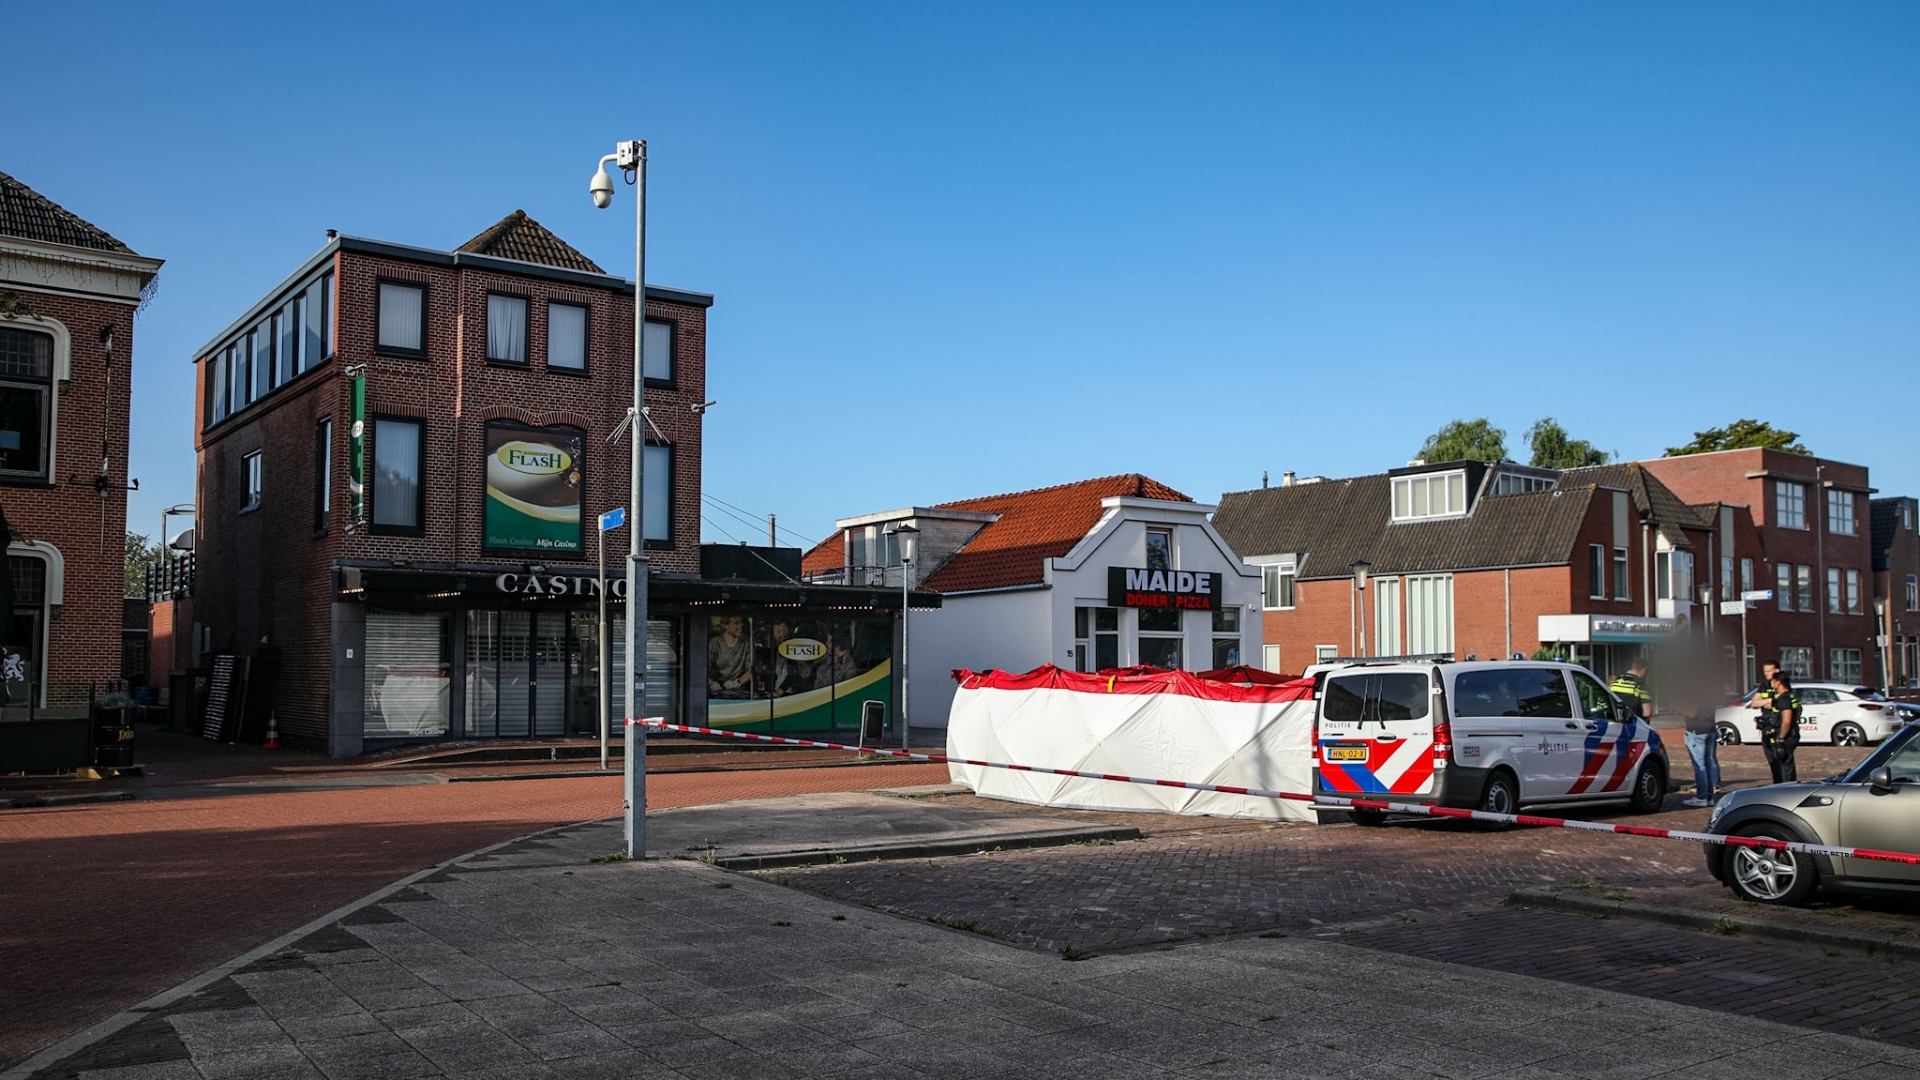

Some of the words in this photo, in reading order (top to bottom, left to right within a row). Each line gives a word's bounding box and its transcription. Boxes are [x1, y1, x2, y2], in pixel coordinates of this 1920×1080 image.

[509, 449, 562, 469] FLASH
[536, 538, 552, 549] Mijn
[554, 539, 577, 549] Casino
[497, 573, 627, 598] CASINO
[1126, 569, 1211, 594] MAIDE
[786, 644, 821, 656] FLASH
[1066, 649, 1074, 658] 15
[1798, 716, 1817, 725] DE
[1333, 750, 1364, 758] HNL-02-X
[1538, 742, 1568, 754] POLITIE
